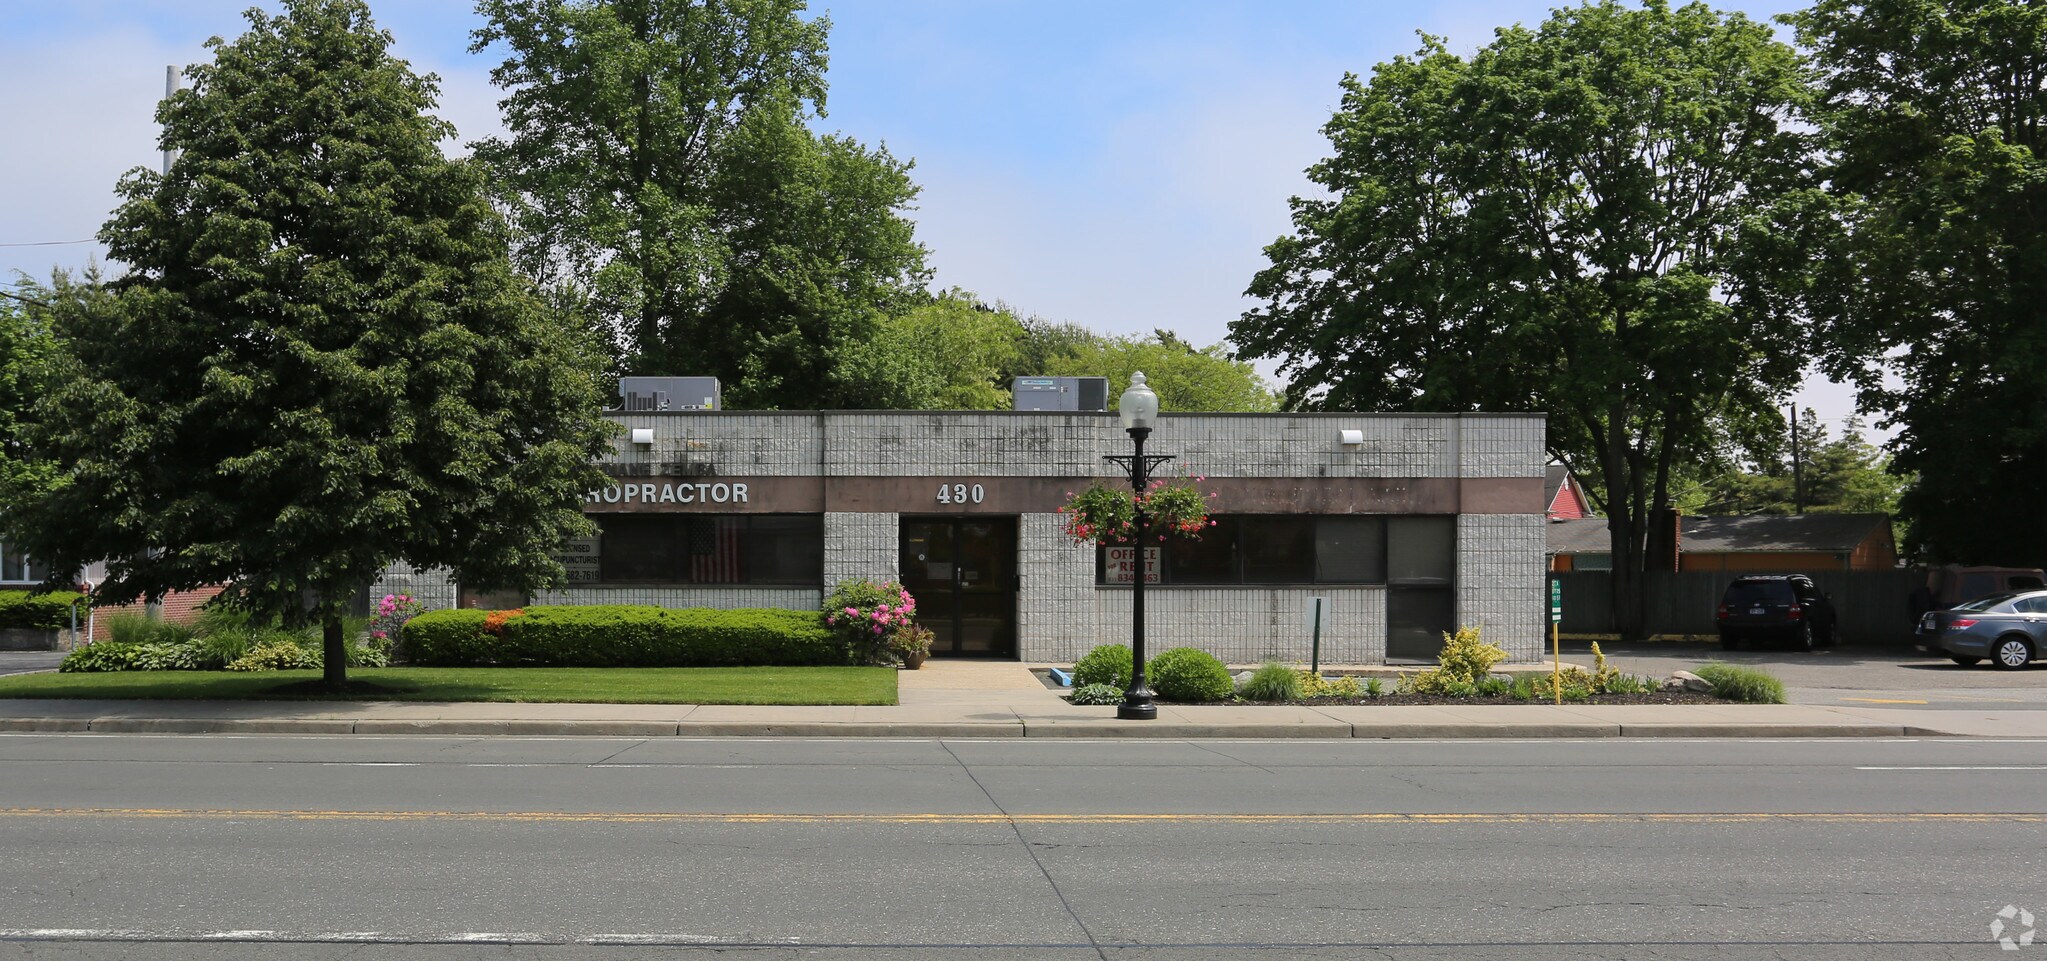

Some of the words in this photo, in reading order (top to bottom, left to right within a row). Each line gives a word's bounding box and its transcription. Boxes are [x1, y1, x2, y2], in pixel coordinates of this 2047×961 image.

[579, 483, 748, 503] ROPRACTOR
[936, 483, 985, 504] 430
[1120, 561, 1155, 572] RET
